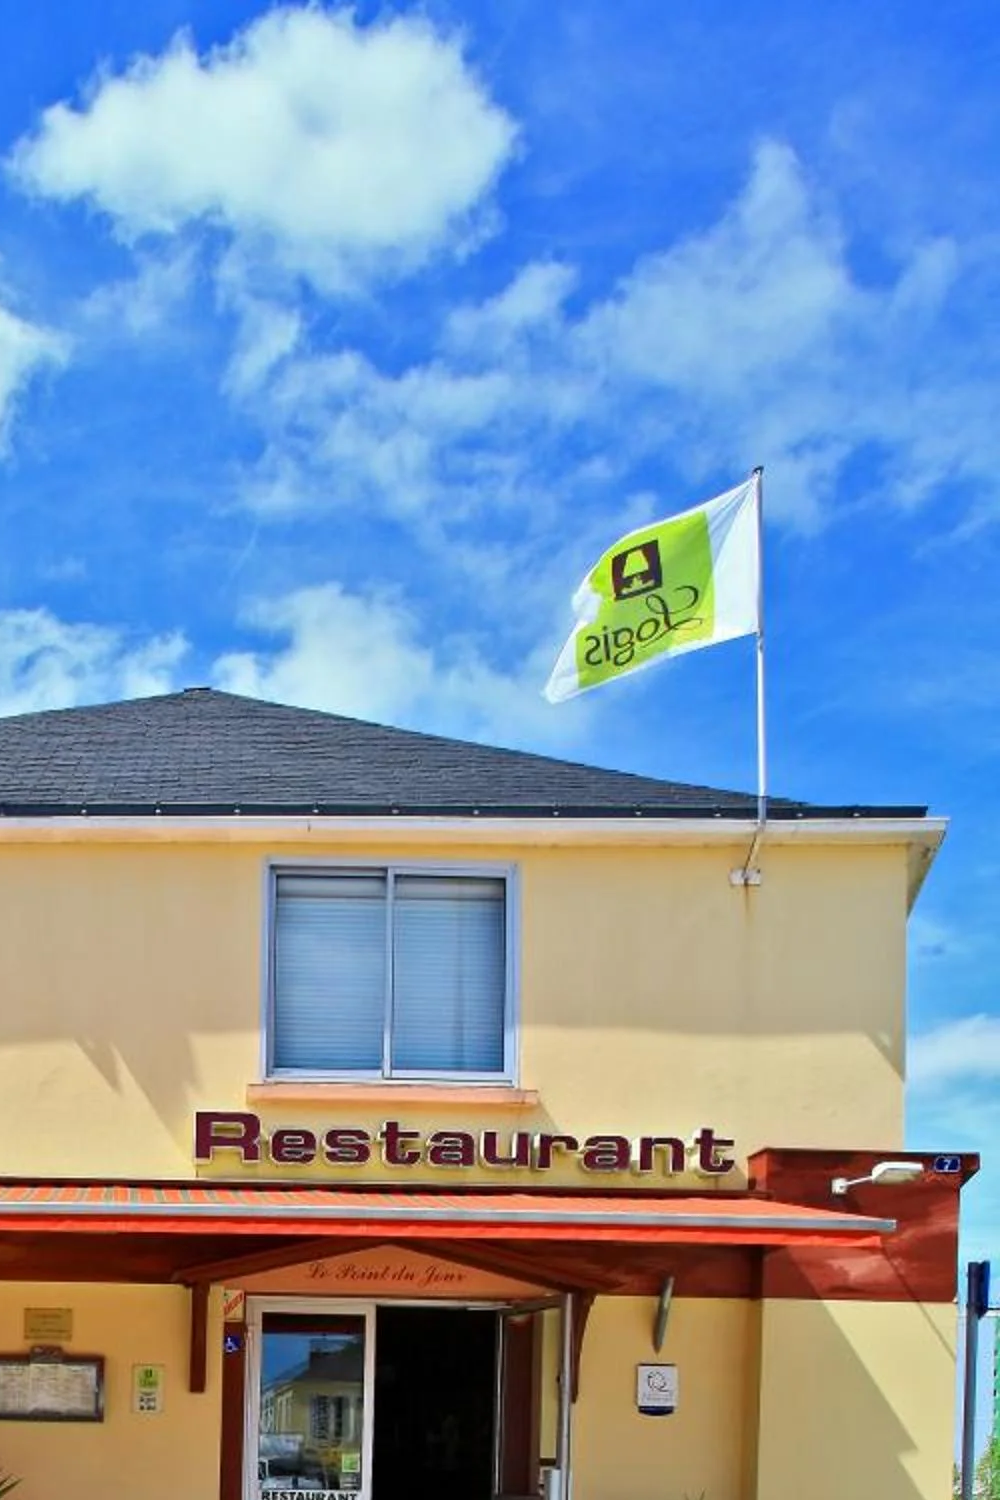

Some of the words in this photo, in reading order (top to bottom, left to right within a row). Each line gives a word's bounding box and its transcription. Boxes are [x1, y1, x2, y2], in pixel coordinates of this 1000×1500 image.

[193, 1109, 736, 1176] Restaurant
[943, 1158, 953, 1171] 7
[304, 1262, 329, 1280] Le
[335, 1263, 391, 1282] Point
[392, 1265, 416, 1282] du
[417, 1264, 468, 1288] Jour
